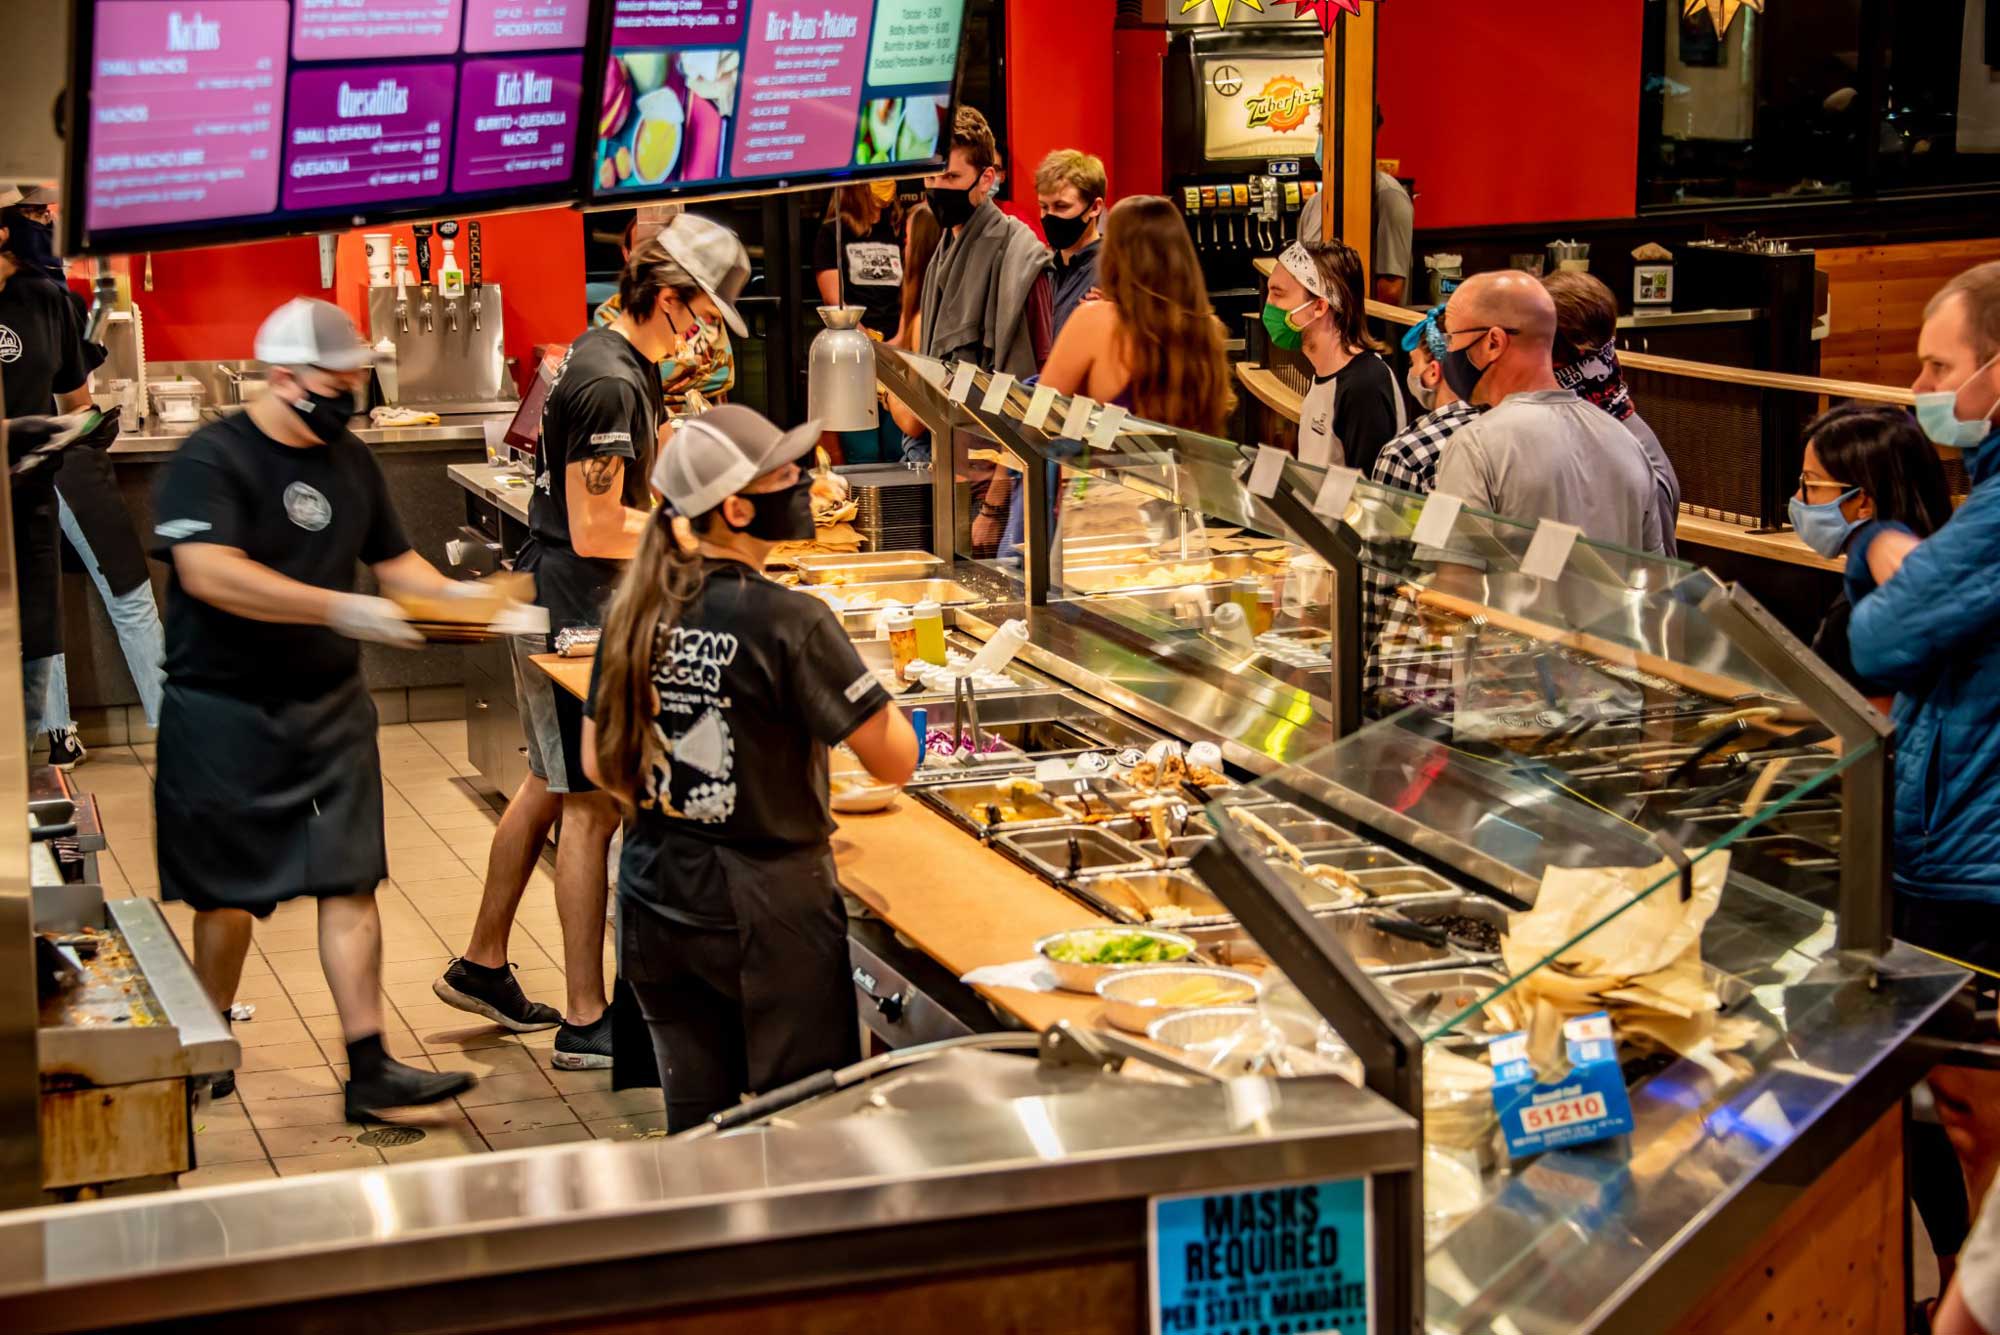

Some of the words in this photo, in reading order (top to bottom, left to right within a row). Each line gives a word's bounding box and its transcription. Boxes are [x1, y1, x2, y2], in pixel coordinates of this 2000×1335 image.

[168, 12, 221, 51] Nachos
[614, 16, 645, 28] Mexican
[645, 15, 679, 27] Chocolate
[680, 14, 697, 28] Chip
[766, 11, 786, 41] Rice
[790, 11, 818, 40] Beans
[821, 10, 858, 38] Potatoes
[337, 78, 410, 119] Quesadillas
[496, 71, 521, 107] Kids
[522, 70, 553, 104] Menu
[293, 127, 325, 145] SMALL
[326, 123, 383, 144] QUESADILLA
[474, 113, 513, 132] BURRITO
[519, 111, 567, 129] QUESADILLA
[501, 130, 539, 147] NACHOS
[290, 157, 350, 179] QUESADILLA
[1527, 1096, 1600, 1128] 51210
[1204, 1185, 1319, 1238] MASKS
[1185, 1226, 1338, 1283] REQUIRED
[1161, 1304, 1197, 1332] PER
[1204, 1296, 1263, 1327] STATE
[1270, 1281, 1365, 1317] MANDATE
